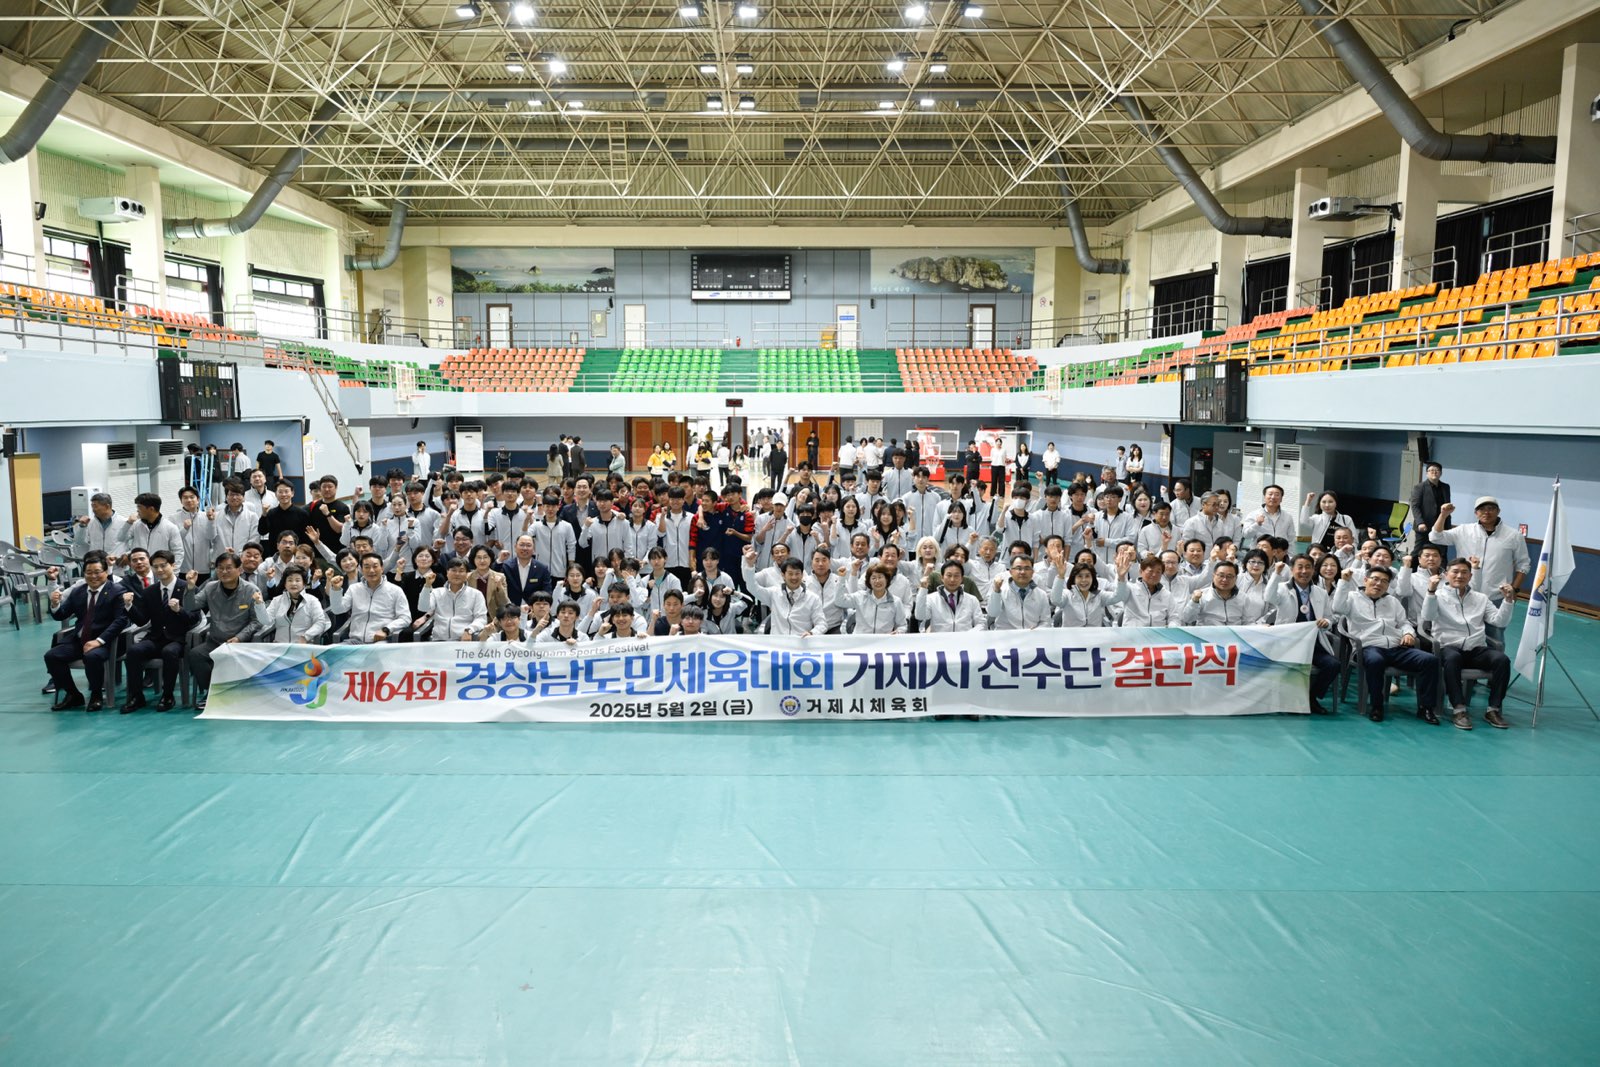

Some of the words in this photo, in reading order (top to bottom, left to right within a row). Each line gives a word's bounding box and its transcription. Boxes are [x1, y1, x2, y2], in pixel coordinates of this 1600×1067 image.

[455, 648, 475, 659] The
[477, 648, 501, 659] 64th
[504, 647, 567, 660] Gyeongnam
[570, 646, 604, 657] Sports
[608, 642, 650, 654] Festival
[342, 669, 447, 703] 제64회
[455, 650, 833, 701] 경상남도민체육대회
[842, 650, 970, 690] 거제시
[978, 647, 1106, 690] 선수단
[1110, 644, 1238, 689] 결단식
[589, 702, 652, 718] 2025년
[657, 701, 685, 718] 5월
[690, 700, 718, 717] 2일
[723, 698, 754, 717] (금)
